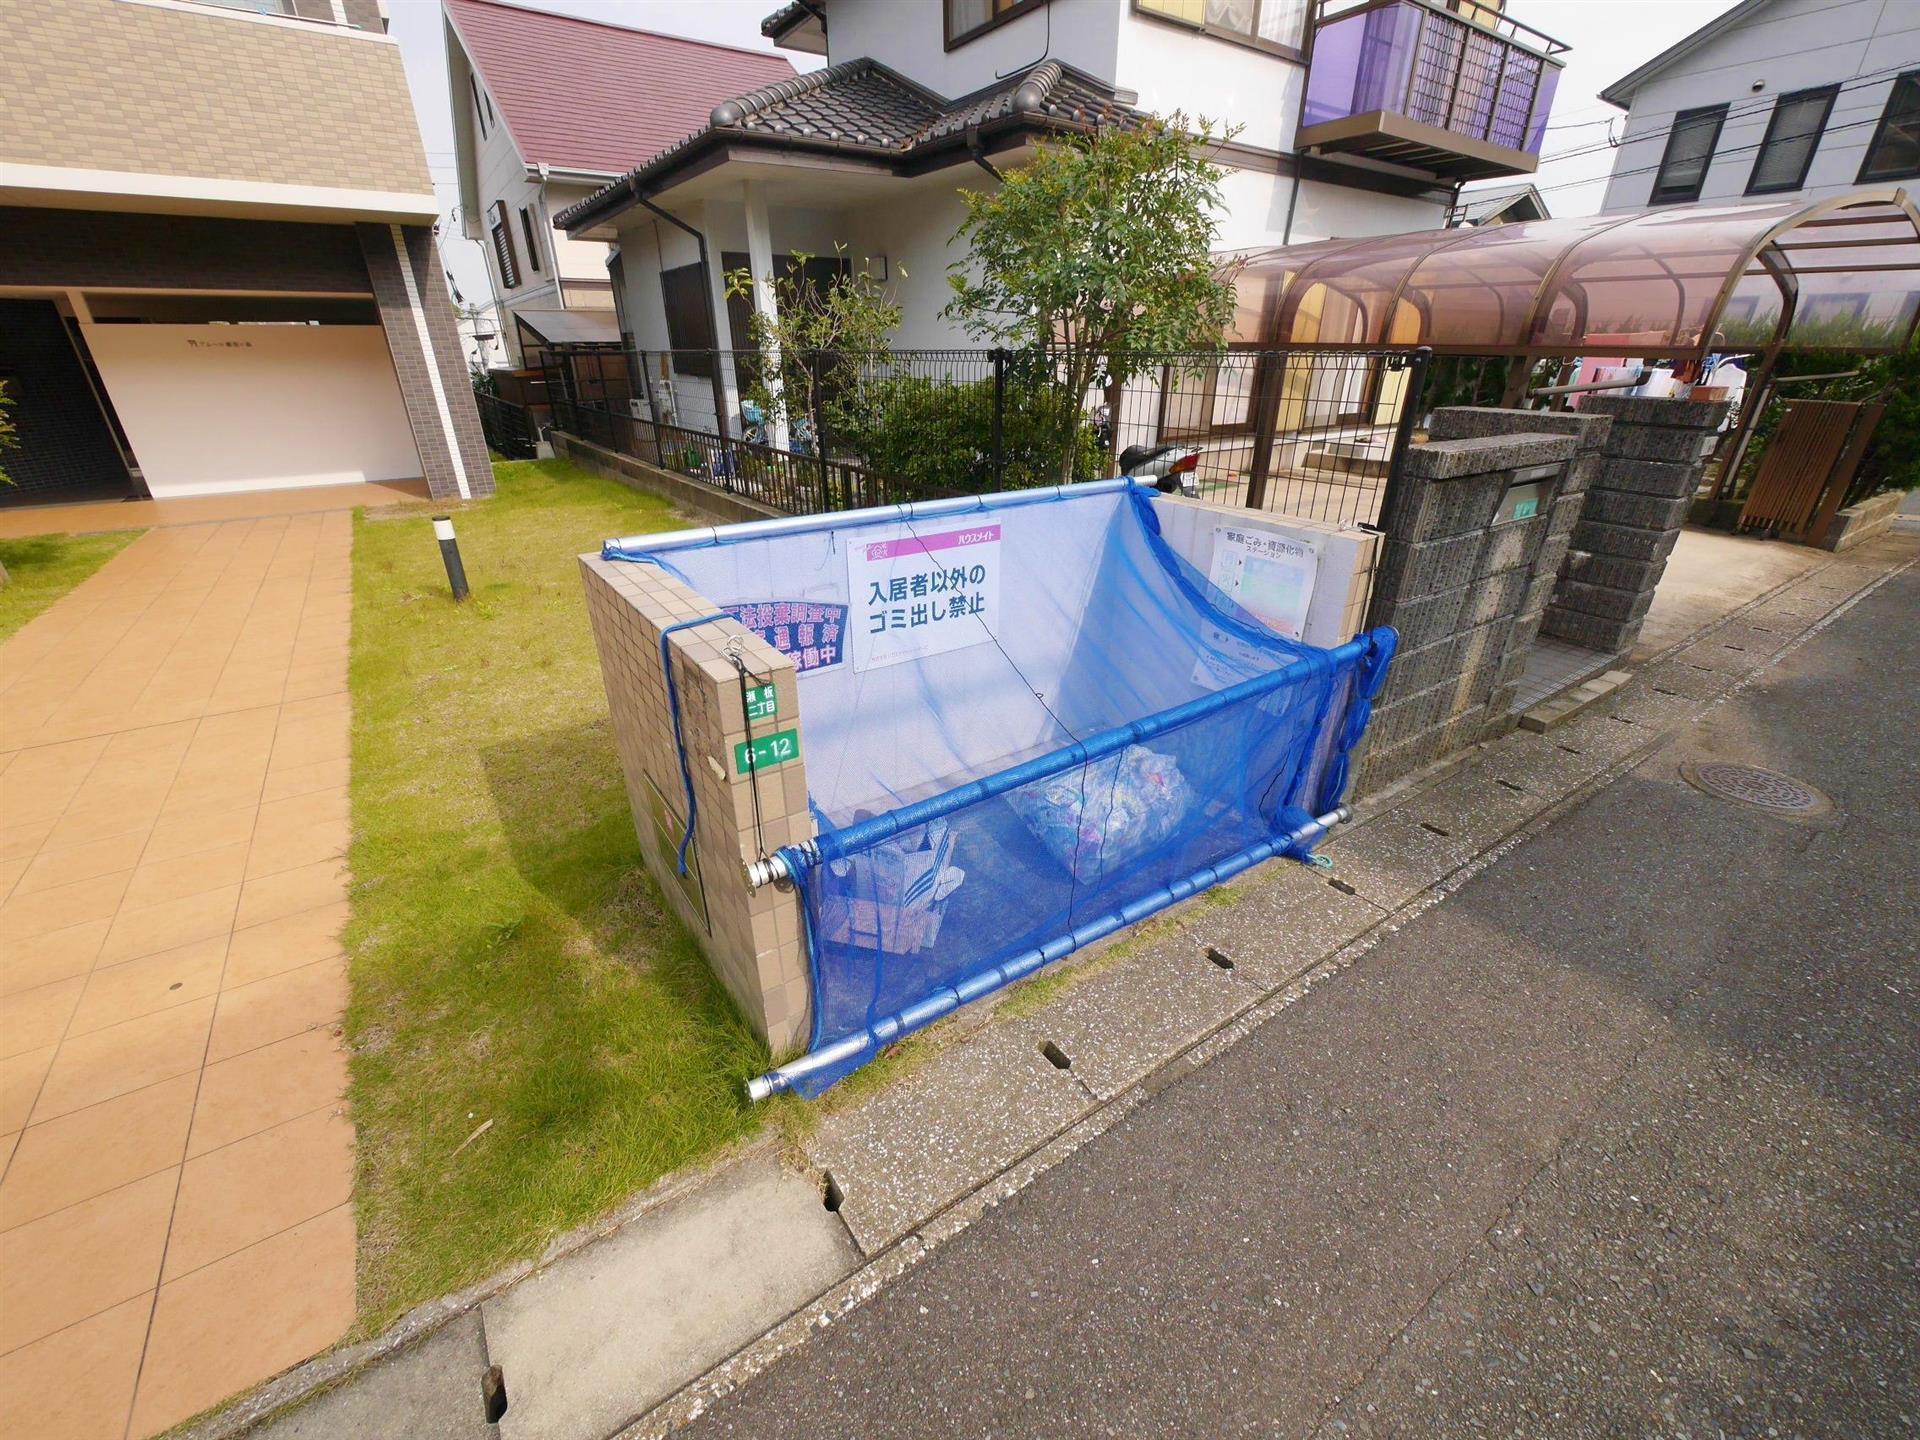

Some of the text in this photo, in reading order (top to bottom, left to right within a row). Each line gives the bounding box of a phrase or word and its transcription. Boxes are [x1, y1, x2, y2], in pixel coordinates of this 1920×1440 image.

[868, 564, 986, 606] 入居者以外の
[869, 592, 985, 634] ゴミ出し禁止
[748, 700, 776, 717] 二丁目
[744, 738, 792, 764] 6-12
